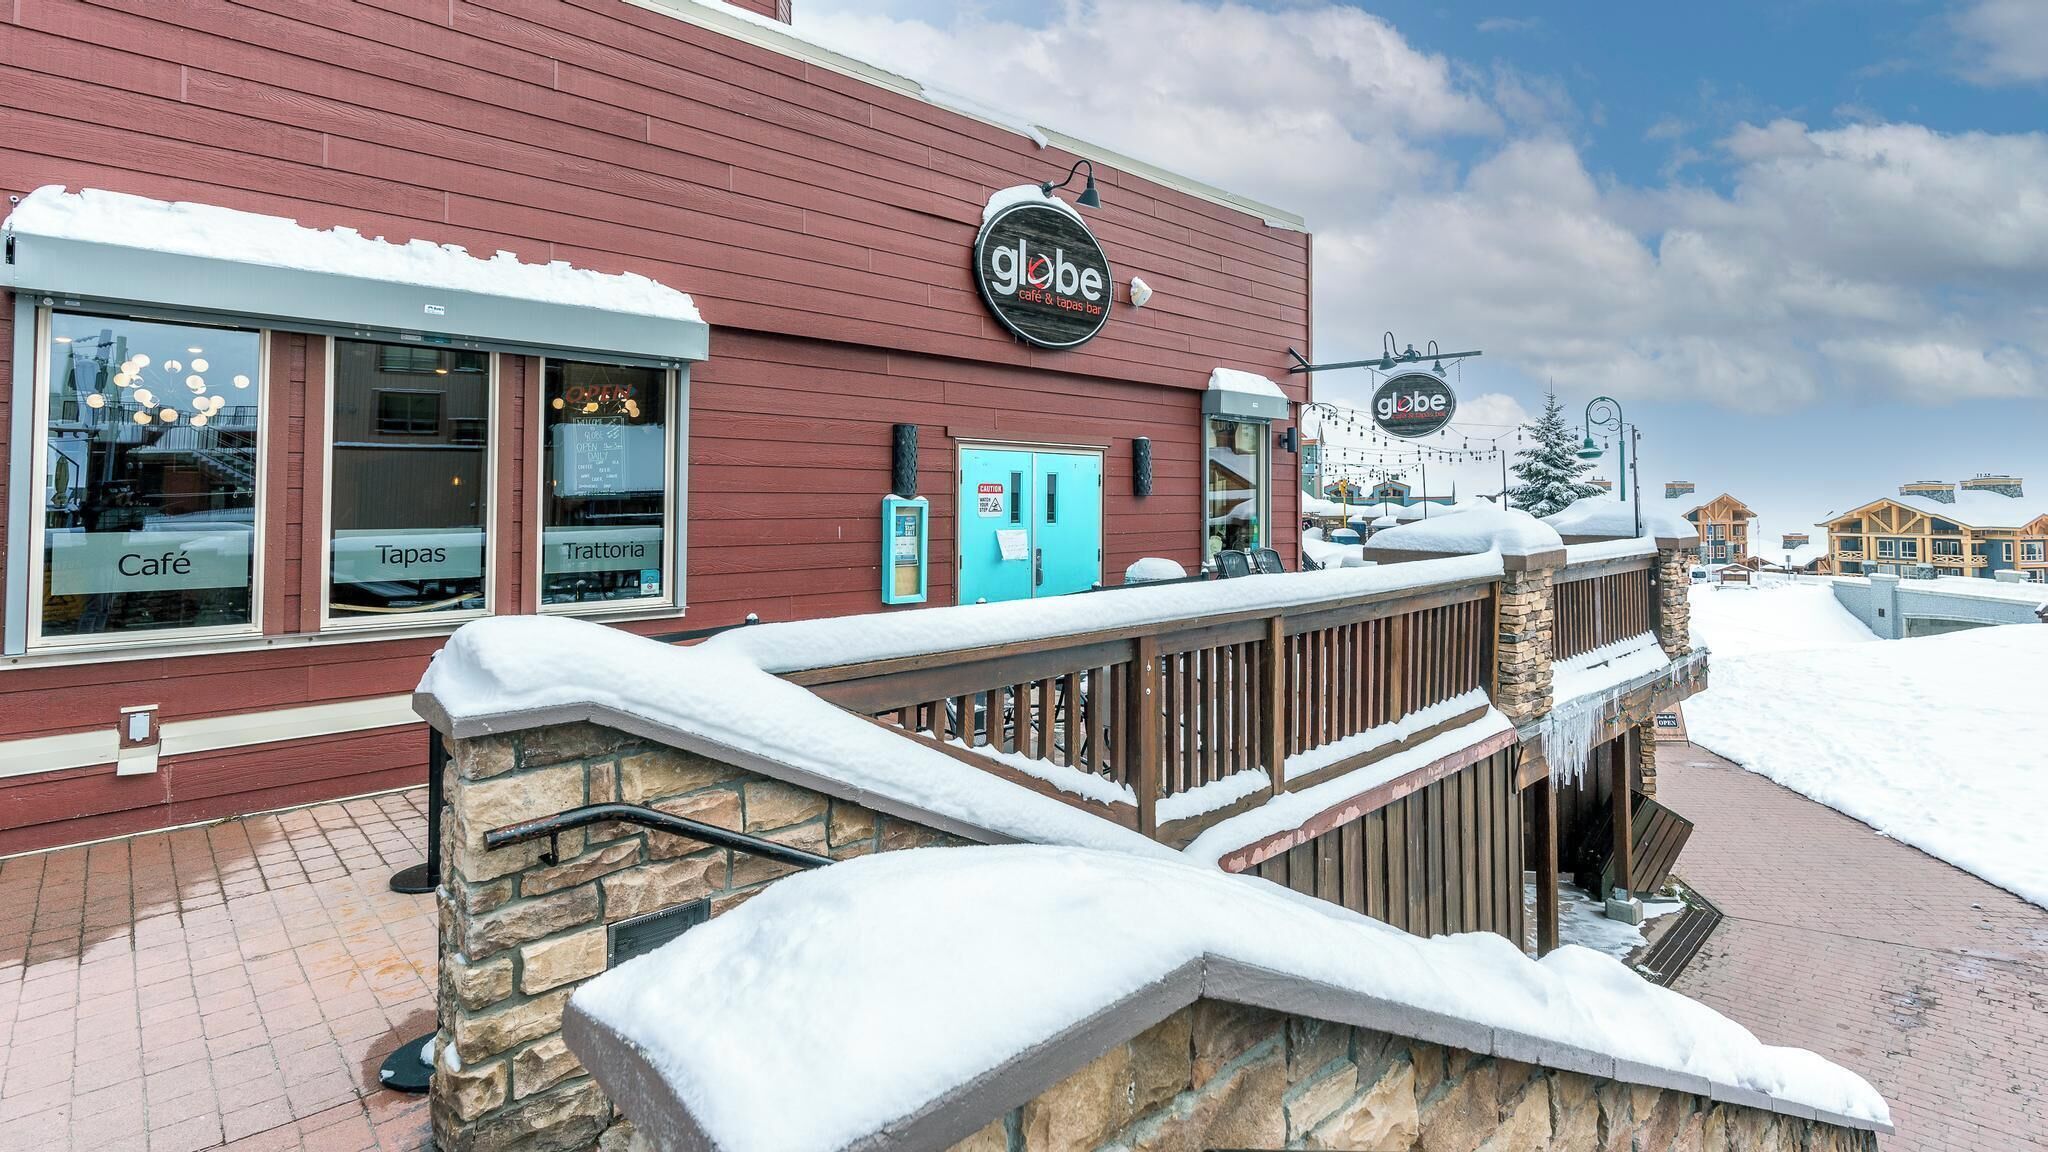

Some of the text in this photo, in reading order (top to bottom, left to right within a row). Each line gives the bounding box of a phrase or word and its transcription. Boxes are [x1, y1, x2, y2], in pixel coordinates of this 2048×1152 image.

[991, 238, 1103, 302] globe
[1018, 288, 1102, 315] café & tapas bar
[564, 383, 634, 404] OPEN
[1377, 390, 1447, 420] globe
[576, 442, 598, 452] OPEN
[979, 485, 1002, 493] CAUTION
[375, 544, 446, 569] Tapas
[562, 541, 645, 560] Trattoria
[118, 550, 191, 577] Café
